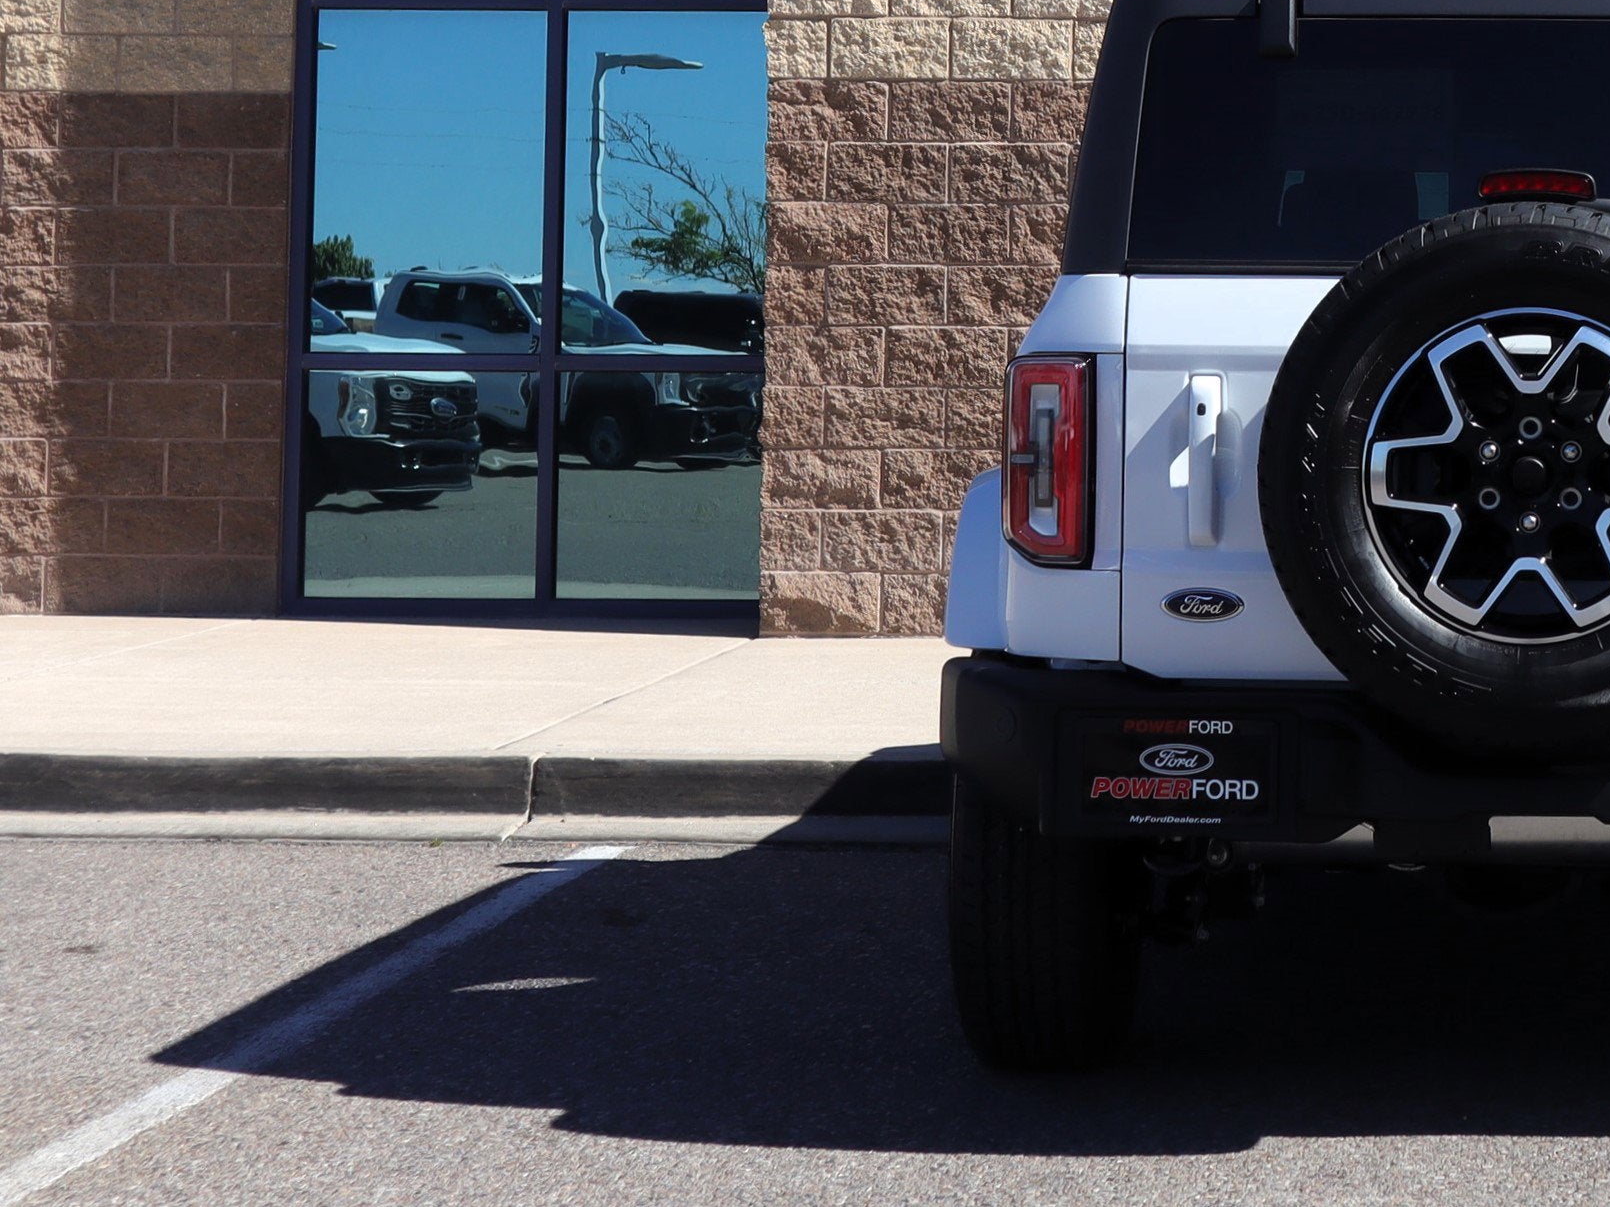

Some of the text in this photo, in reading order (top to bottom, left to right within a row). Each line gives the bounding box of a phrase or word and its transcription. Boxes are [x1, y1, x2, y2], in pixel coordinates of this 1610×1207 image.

[1179, 594, 1224, 615] Ford
[1123, 719, 1234, 735] POWERFORD
[1154, 749, 1199, 769] Ford
[1091, 776, 1260, 800] POWERFORD
[1129, 815, 1222, 825] MyFordDealer.com
